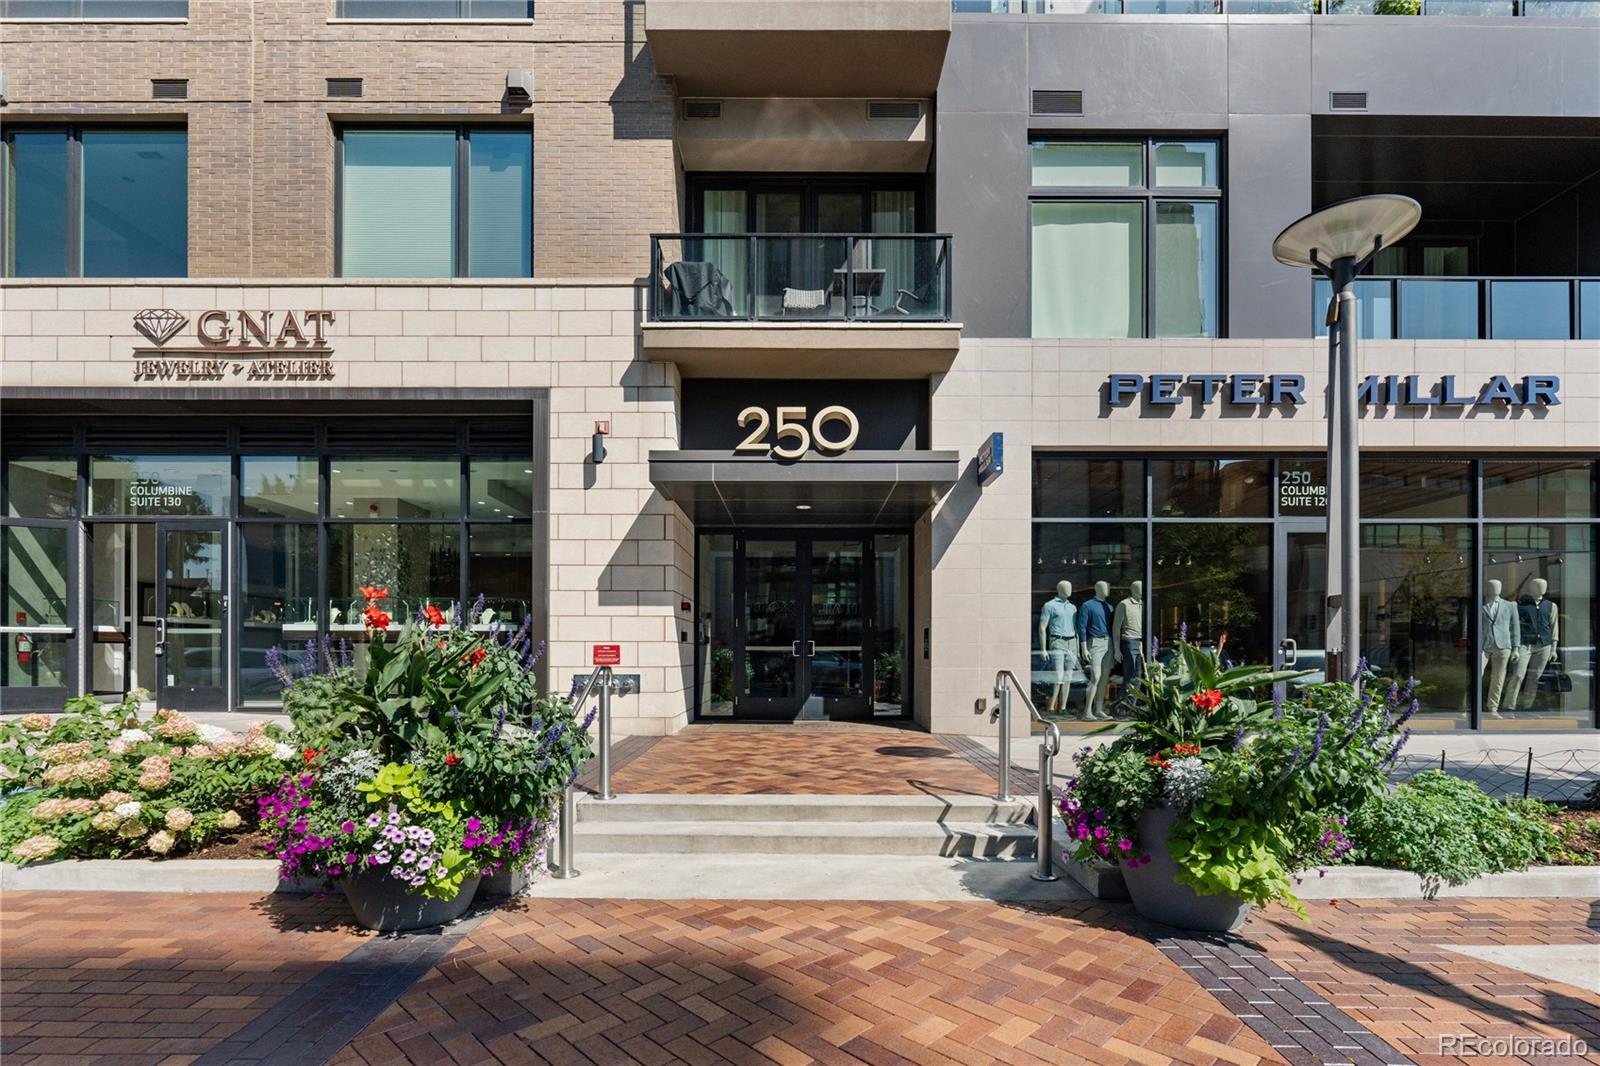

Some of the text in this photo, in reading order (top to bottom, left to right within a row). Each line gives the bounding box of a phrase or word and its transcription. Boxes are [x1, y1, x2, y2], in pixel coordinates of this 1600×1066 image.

[197, 309, 336, 345] GNAT
[133, 360, 335, 376] JEWELRY ATELIER
[1107, 374, 1307, 405] PETER
[735, 405, 860, 459] 250
[1281, 471, 1311, 484] 250
[130, 486, 193, 496] COLUMBINE
[130, 497, 182, 507] SUITE 130
[1281, 497, 1312, 506] SUITE
